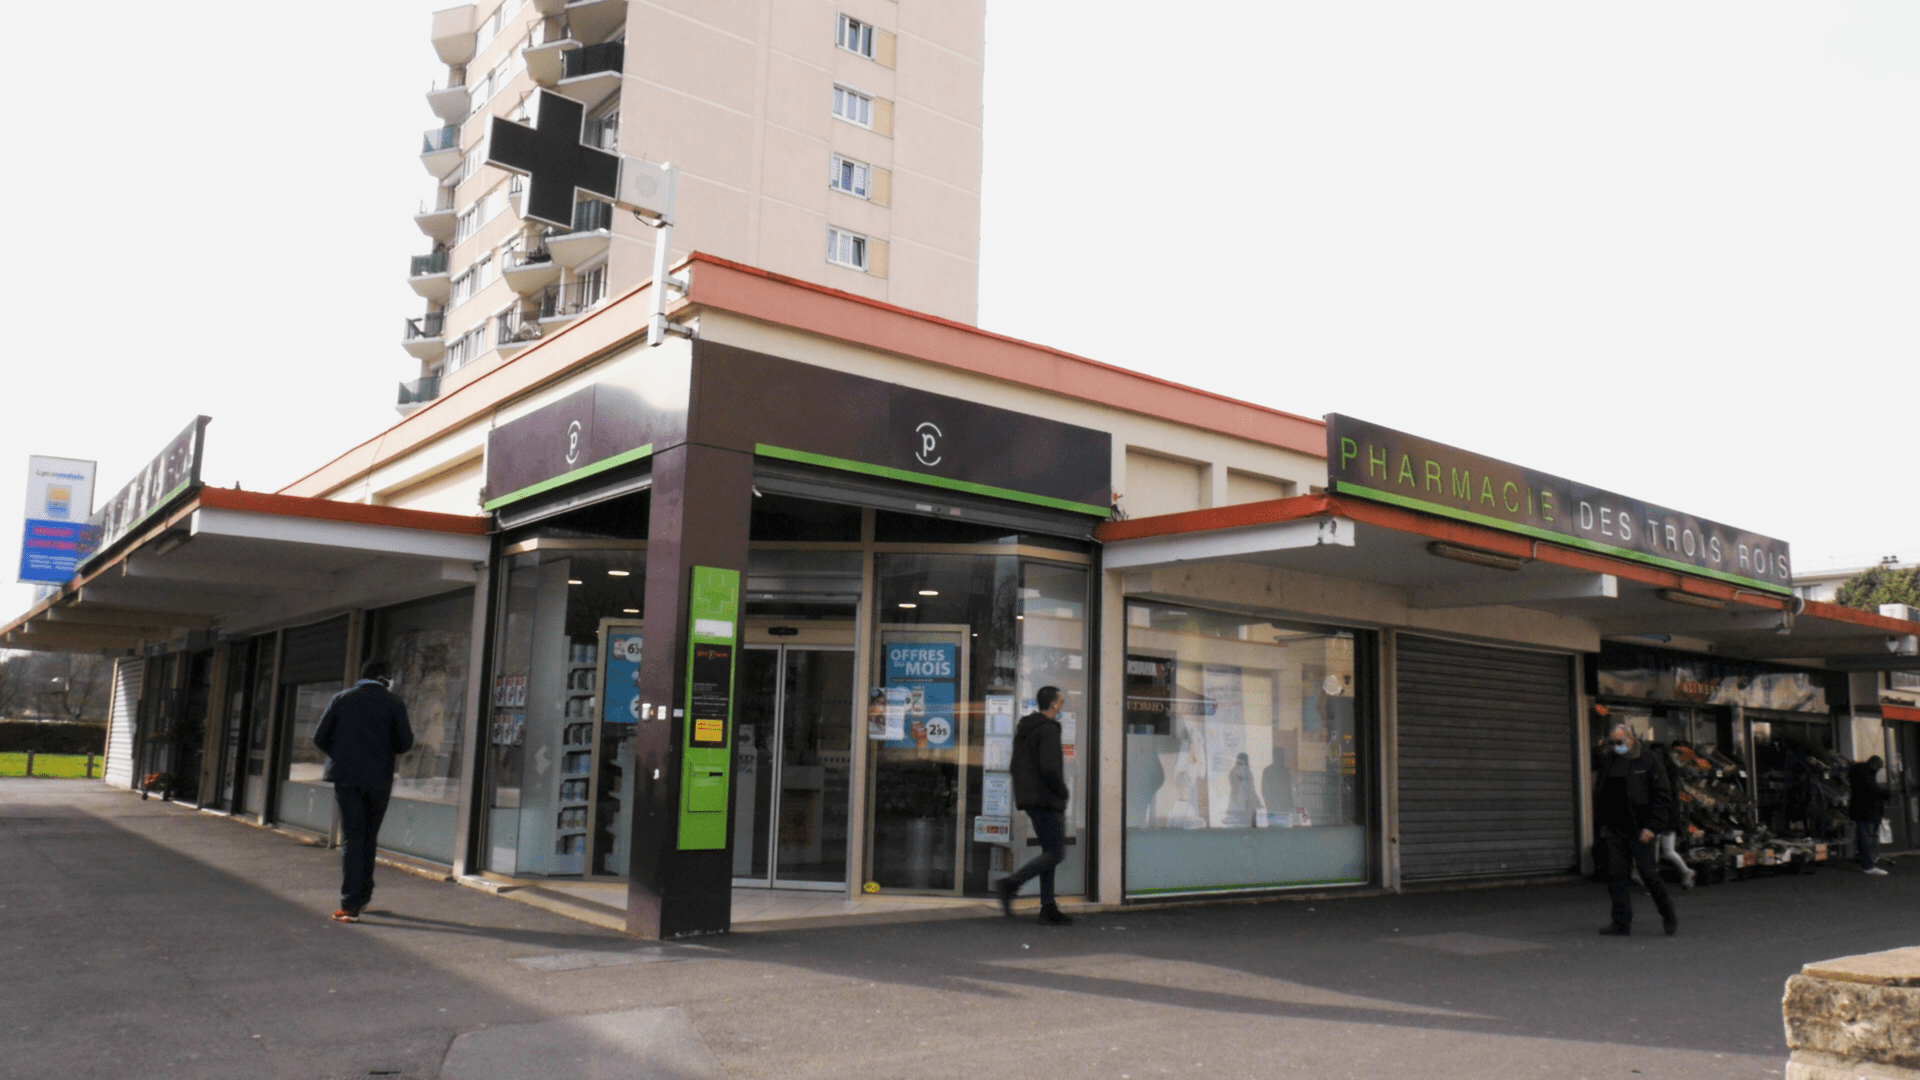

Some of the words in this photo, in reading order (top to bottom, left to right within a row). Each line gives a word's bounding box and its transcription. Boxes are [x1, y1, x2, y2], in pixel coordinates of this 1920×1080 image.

[1340, 437, 1555, 522] PHARMACIE
[1580, 501, 1632, 540] DES
[1648, 519, 1722, 562] TROIS
[1738, 544, 1788, 579] ROIS
[890, 649, 946, 662] OFFRES
[905, 661, 951, 676] MOIS
